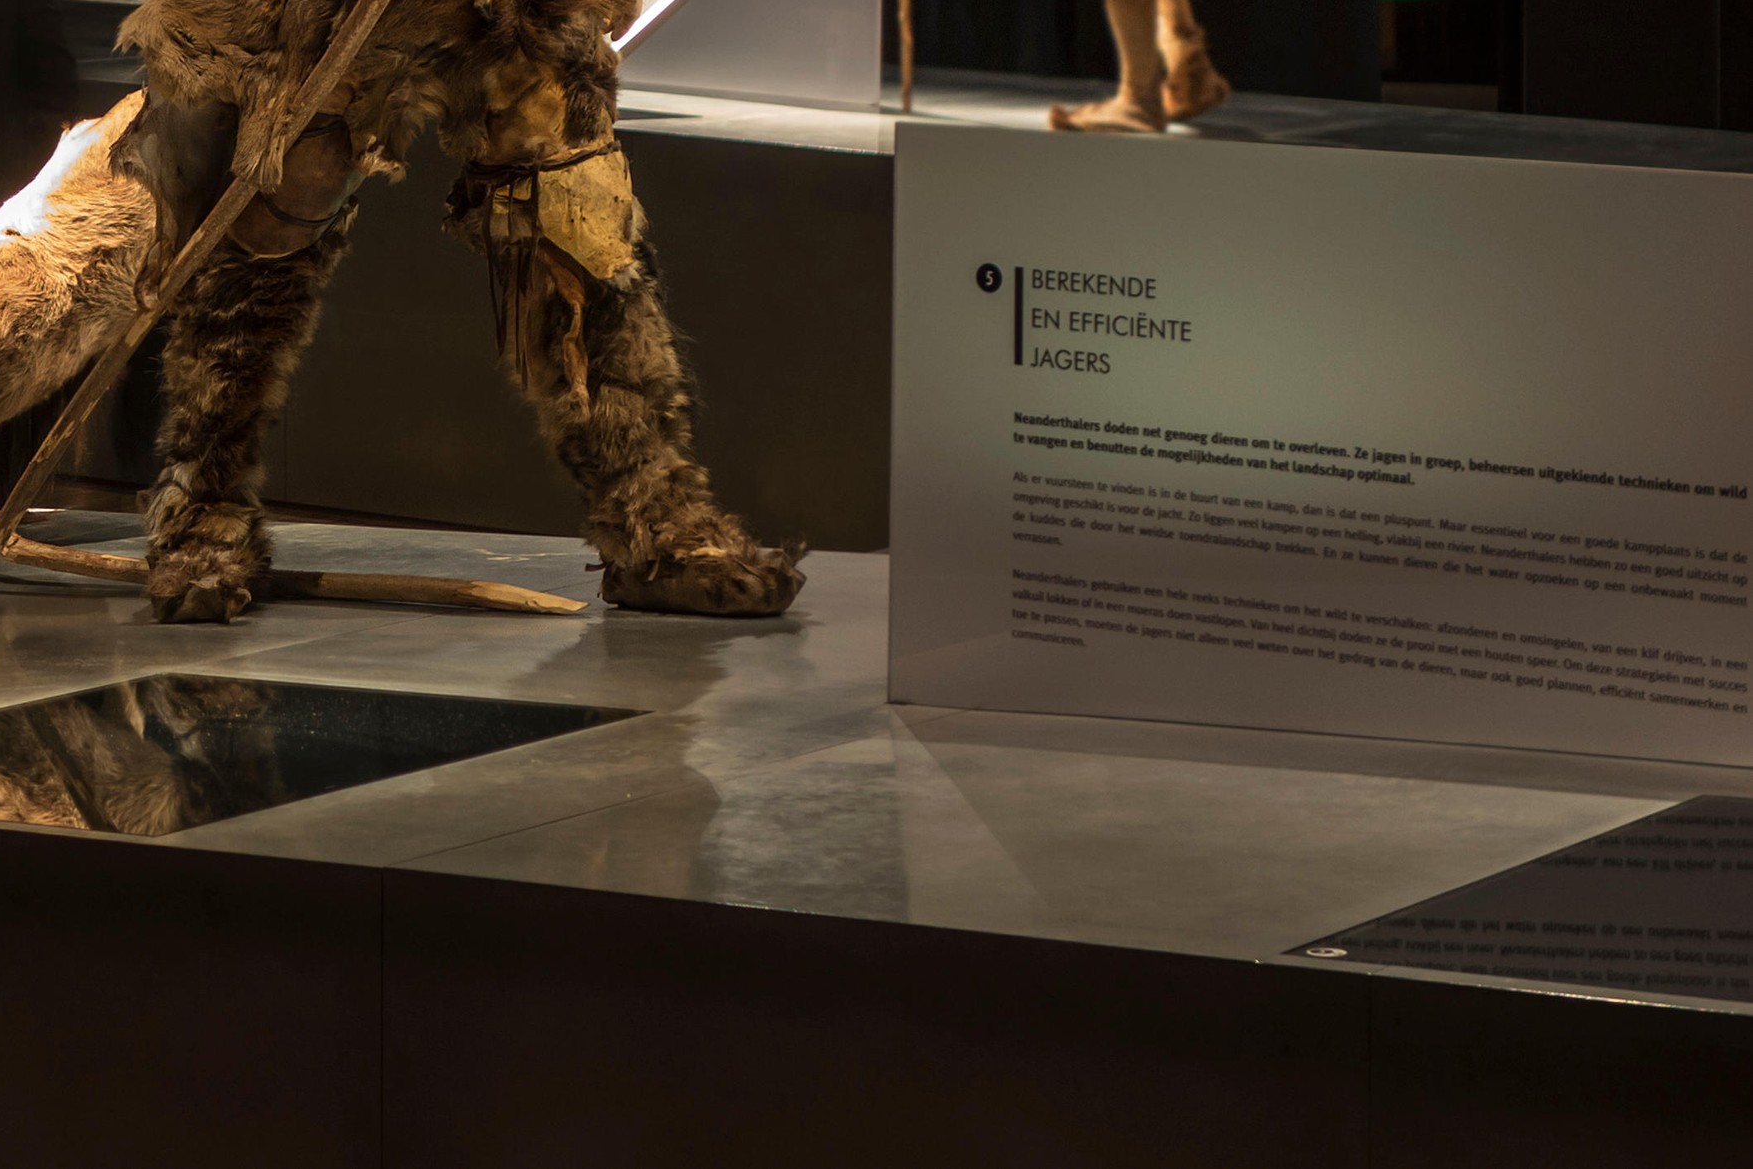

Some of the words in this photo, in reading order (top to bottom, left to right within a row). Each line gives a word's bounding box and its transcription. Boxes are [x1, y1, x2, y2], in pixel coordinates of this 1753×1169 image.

[1032, 269, 1157, 299] BEREKENDE
[1031, 308, 1060, 331] EN
[1070, 311, 1193, 342] EFFICIËNTE
[1031, 347, 1111, 374] JAGERS
[1014, 412, 1100, 432] Neanderthalers
[1104, 421, 1139, 436] doden
[1143, 427, 1160, 438] net
[1165, 430, 1208, 446] genoeg
[1211, 432, 1248, 447] dieren
[1252, 438, 1269, 449] om
[1273, 439, 1285, 451] te
[1289, 442, 1349, 457] overleven.
[1354, 446, 1368, 459] Ze
[1373, 448, 1406, 465] jagen
[1410, 452, 1421, 465] in
[1426, 456, 1464, 472] groep,
[1469, 458, 1534, 476] beheersen
[1539, 465, 1614, 484] uitgekiende
[1618, 474, 1690, 492] technieken
[1694, 483, 1714, 495] om
[1719, 484, 1746, 498] wild
[1014, 432, 1025, 443] te
[1027, 435, 1067, 449] vangen
[1070, 439, 1084, 449] en
[1087, 439, 1137, 455] benutten
[1140, 444, 1154, 457] de
[1158, 449, 1243, 466] mogelijkheden
[1247, 458, 1267, 469] van
[1270, 458, 1289, 471] het
[1293, 460, 1354, 481] landschap
[1357, 469, 1415, 484] optimaal.
[1440, 517, 1466, 532] Maar
[1471, 523, 1526, 539] essentieel
[1531, 530, 1555, 542] voor
[1560, 533, 1580, 545] een
[1585, 535, 1619, 549] goede
[1624, 538, 1690, 557] kampplaats
[1710, 547, 1728, 561] dat
[1733, 549, 1746, 563] de
[1443, 559, 1460, 573] die
[1465, 561, 1482, 575] het
[1489, 567, 1519, 580] water
[1525, 571, 1579, 587] opzoeken
[1584, 578, 1599, 592] op
[1604, 580, 1625, 592] een
[1631, 582, 1693, 600] onbewaakt
[1700, 591, 1746, 606] moment
[1481, 543, 1565, 564] Neanderthalers
[1569, 553, 1611, 570] hebben
[1630, 563, 1651, 574] een
[1655, 565, 1683, 579] goed
[1687, 567, 1728, 583] uitzicht
[1733, 574, 1747, 589] op
[1437, 621, 1498, 640] afzonderen
[1502, 631, 1516, 642] en
[1592, 642, 1611, 654] van
[1616, 645, 1637, 657] een
[1642, 646, 1659, 660] klif
[1711, 654, 1721, 668] in
[1726, 659, 1746, 671] een
[1438, 644, 1458, 655] met
[1461, 647, 1481, 658] een
[1485, 647, 1523, 663] houten
[1563, 657, 1582, 671] Om
[1586, 659, 1612, 675] deze
[1616, 665, 1679, 683] strategieën
[1683, 675, 1704, 687] met
[1709, 678, 1745, 692] succes
[1460, 668, 1487, 680] maar
[1492, 671, 1511, 683] ook
[1516, 675, 1543, 688] goed
[1600, 684, 1645, 701] efficiënt
[1650, 692, 1728, 712] samenwerken
[1733, 703, 1746, 714] en
